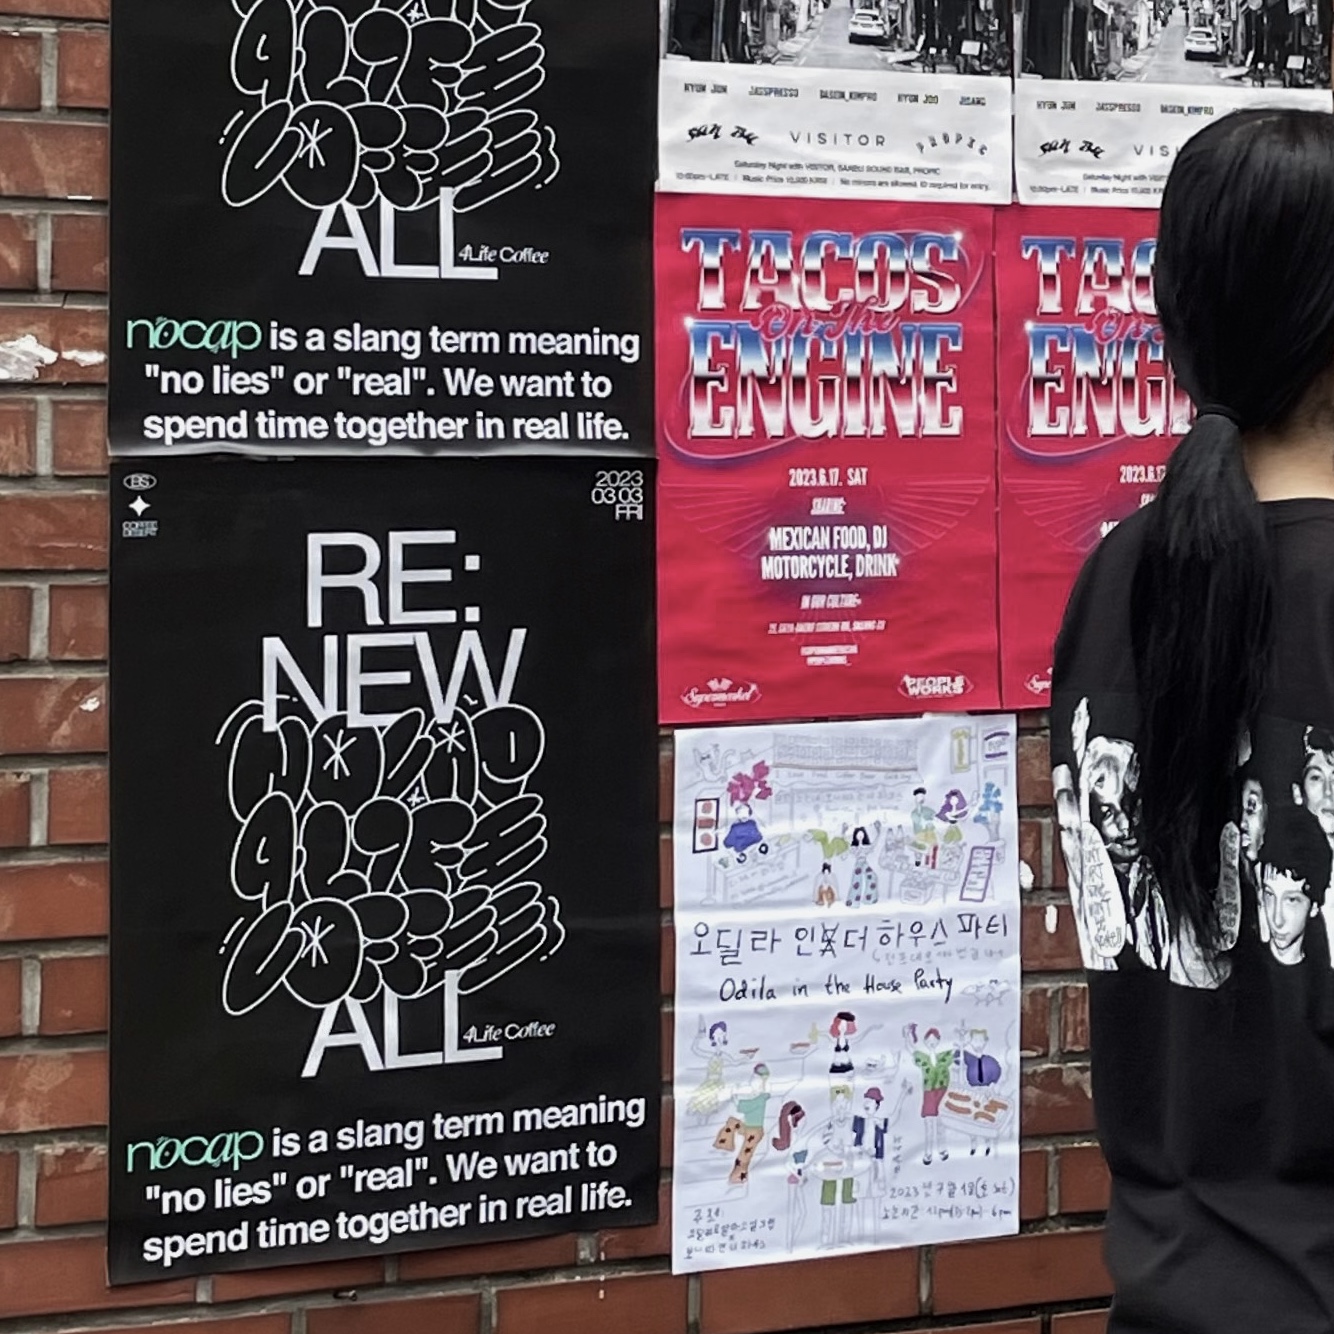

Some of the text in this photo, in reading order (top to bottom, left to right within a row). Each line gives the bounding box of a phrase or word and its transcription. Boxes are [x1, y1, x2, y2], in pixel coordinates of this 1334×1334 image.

[789, 131, 887, 147] VISITOR
[298, 187, 499, 279] ALL
[459, 245, 549, 264] 4Life Coffee
[680, 228, 962, 315] TACOS
[269, 323, 297, 351] is
[305, 329, 325, 351] a
[333, 323, 421, 358] slang
[429, 329, 500, 354] term
[508, 328, 640, 362] meaning
[145, 365, 612, 398] "no lies" or "real". We want to
[687, 320, 963, 440] ENGINE
[143, 410, 629, 446] spend time together in real life.
[595, 470, 644, 487] 2023
[847, 467, 868, 486] SAT
[615, 504, 644, 521] FRI
[768, 525, 888, 552] MEXICAN FOOD, DJ
[307, 530, 480, 628] RE:
[761, 553, 899, 581] MOTORCYCLE, DRINK
[262, 628, 527, 732] NEW
[690, 922, 781, 966] 오딜라
[876, 919, 948, 947] 하우스
[957, 913, 1008, 938] 파티
[719, 963, 953, 1003] Odila in the House Party
[301, 970, 503, 1078] ALL
[463, 1021, 556, 1044] 4Life Coffee
[272, 1128, 300, 1157] is
[308, 1131, 328, 1152] a
[336, 1119, 424, 1155] slang
[432, 1114, 504, 1141] term
[512, 1095, 646, 1136] meaning
[145, 1140, 618, 1215] "no lies" or "real". We want to
[143, 1181, 633, 1266] spend time together in real life.
